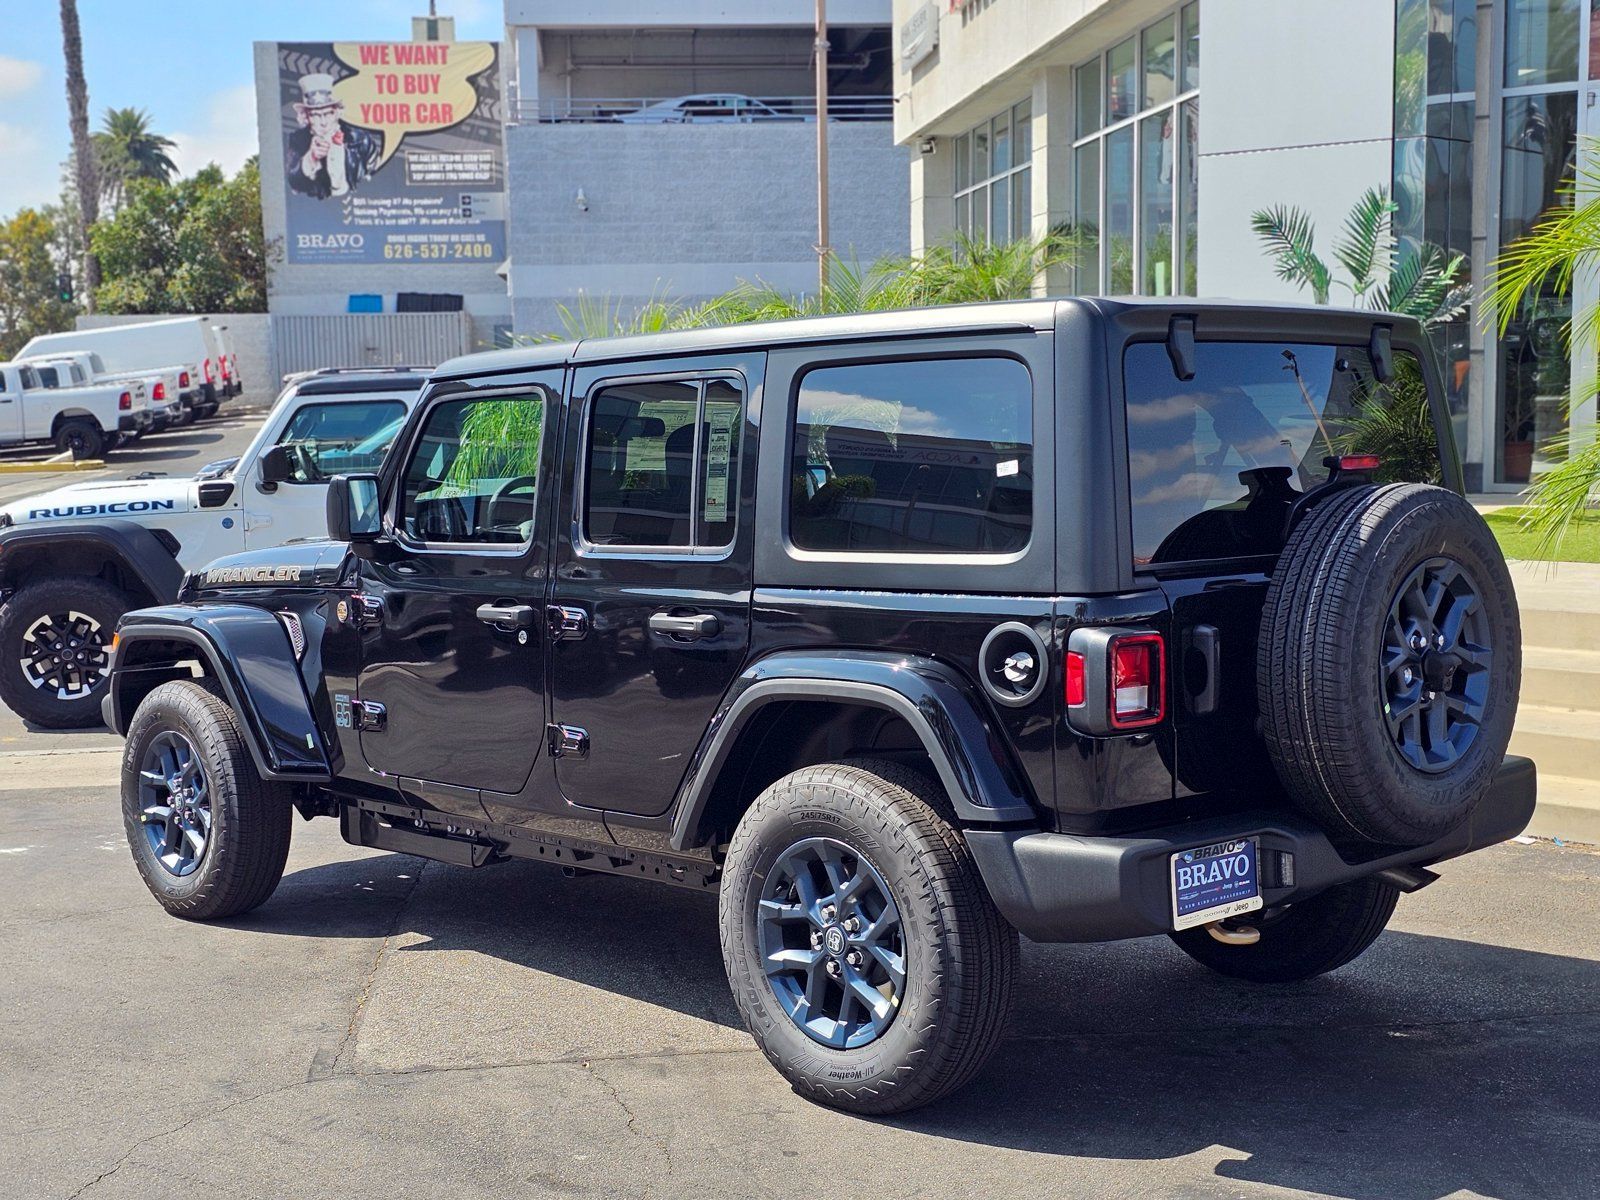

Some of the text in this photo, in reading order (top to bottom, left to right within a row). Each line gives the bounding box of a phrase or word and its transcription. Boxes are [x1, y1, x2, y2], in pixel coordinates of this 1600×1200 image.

[359, 45, 449, 65] WE WANT
[375, 74, 441, 94] TO BUY
[360, 103, 453, 124] YOUR CAR
[297, 234, 364, 248] BRAVO
[384, 244, 492, 258] 626-537-2400
[29, 500, 174, 519] RUBICON
[205, 565, 300, 584] WRANGLER
[1194, 841, 1236, 860] BRAVO
[1177, 854, 1249, 890] BRAVO
[827, 1065, 875, 1080] All-Weather
